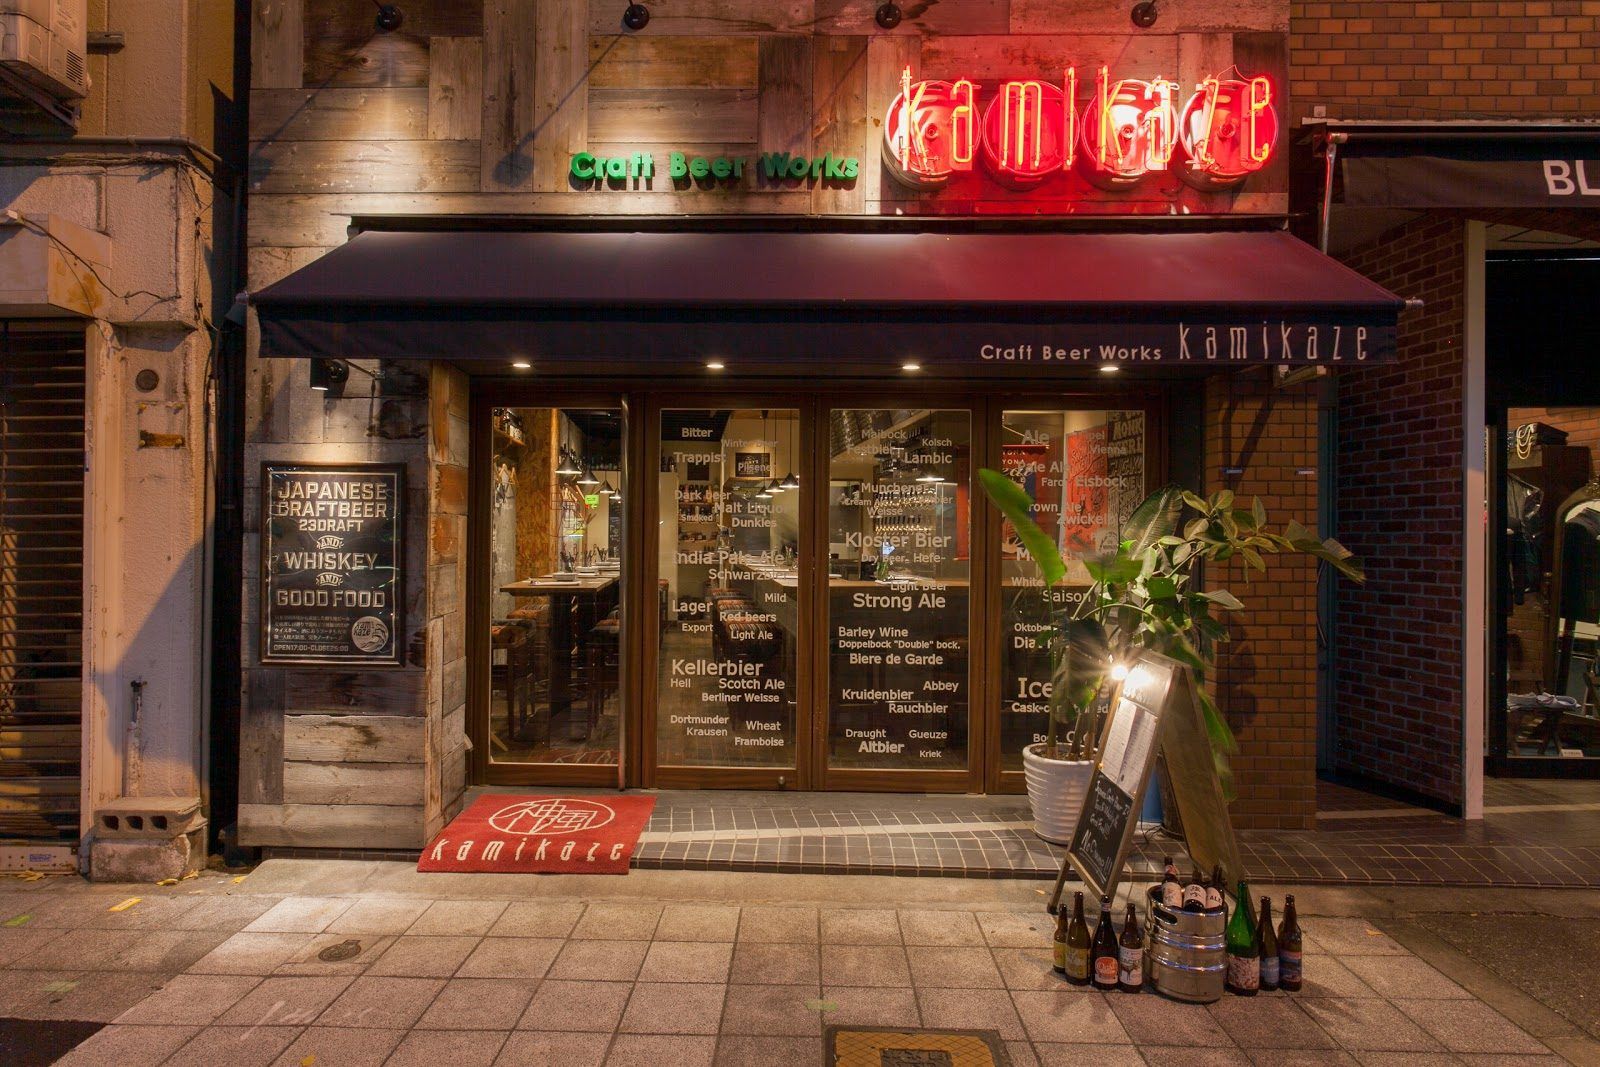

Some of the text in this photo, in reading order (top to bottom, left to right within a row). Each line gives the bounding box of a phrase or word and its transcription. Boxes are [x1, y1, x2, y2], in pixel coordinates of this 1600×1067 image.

[900, 65, 1271, 171] kamikaze
[570, 151, 860, 184] Craft Beer Works
[980, 321, 1368, 361] Craft Beer Works kamikaze
[681, 427, 713, 438] Bitter
[861, 429, 907, 439] Maibock
[1021, 430, 1050, 445] Ale
[922, 438, 952, 447] Kolsch
[673, 451, 726, 465] Trappist
[905, 452, 952, 464] Lambic
[1075, 476, 1127, 487] Eisbock
[277, 481, 388, 500] JAPANESE
[675, 490, 702, 501] Dark
[277, 500, 387, 518] DRAFTBEER
[714, 502, 742, 513] Malt
[867, 506, 904, 516] Weisse
[1028, 503, 1058, 512] rown
[298, 519, 364, 532] 23DRAFT
[320, 537, 340, 548] AND
[845, 532, 952, 548] Kloster Bier
[285, 551, 378, 570] WHISKEY
[319, 574, 339, 585] AND
[890, 582, 947, 593] Light Beer
[276, 589, 386, 608] GOOD FOOD
[764, 593, 787, 603] Mild
[1042, 590, 1091, 602] Saison
[672, 600, 713, 615] Lager
[853, 593, 946, 611] Strong Ale
[720, 612, 777, 622] Red beers
[682, 623, 713, 634] Export
[838, 627, 909, 639] Barley Wine
[731, 630, 773, 641] Light Ale
[838, 640, 891, 649] Doppelbock
[937, 640, 961, 649] bock.
[850, 653, 944, 665] Biere de Garde
[672, 659, 764, 676] Kellerbier
[670, 678, 691, 688] Hell
[719, 678, 786, 689] Scotch Ale
[923, 681, 959, 692] Abbey
[1018, 677, 1053, 698] Ice
[702, 693, 780, 702] Berliner Weisse
[842, 689, 914, 700] Kruidenbier
[889, 703, 948, 714] Rauchbier
[670, 714, 729, 724] Dortmunder
[746, 721, 781, 731] Wheat
[686, 727, 728, 737] Krausen
[846, 729, 887, 740] Draught
[909, 729, 948, 739] Gueuze
[735, 737, 784, 747] Framboise
[858, 741, 905, 754] Altbier
[919, 750, 942, 758] Kriek
[431, 837, 625, 862] kamikaze
